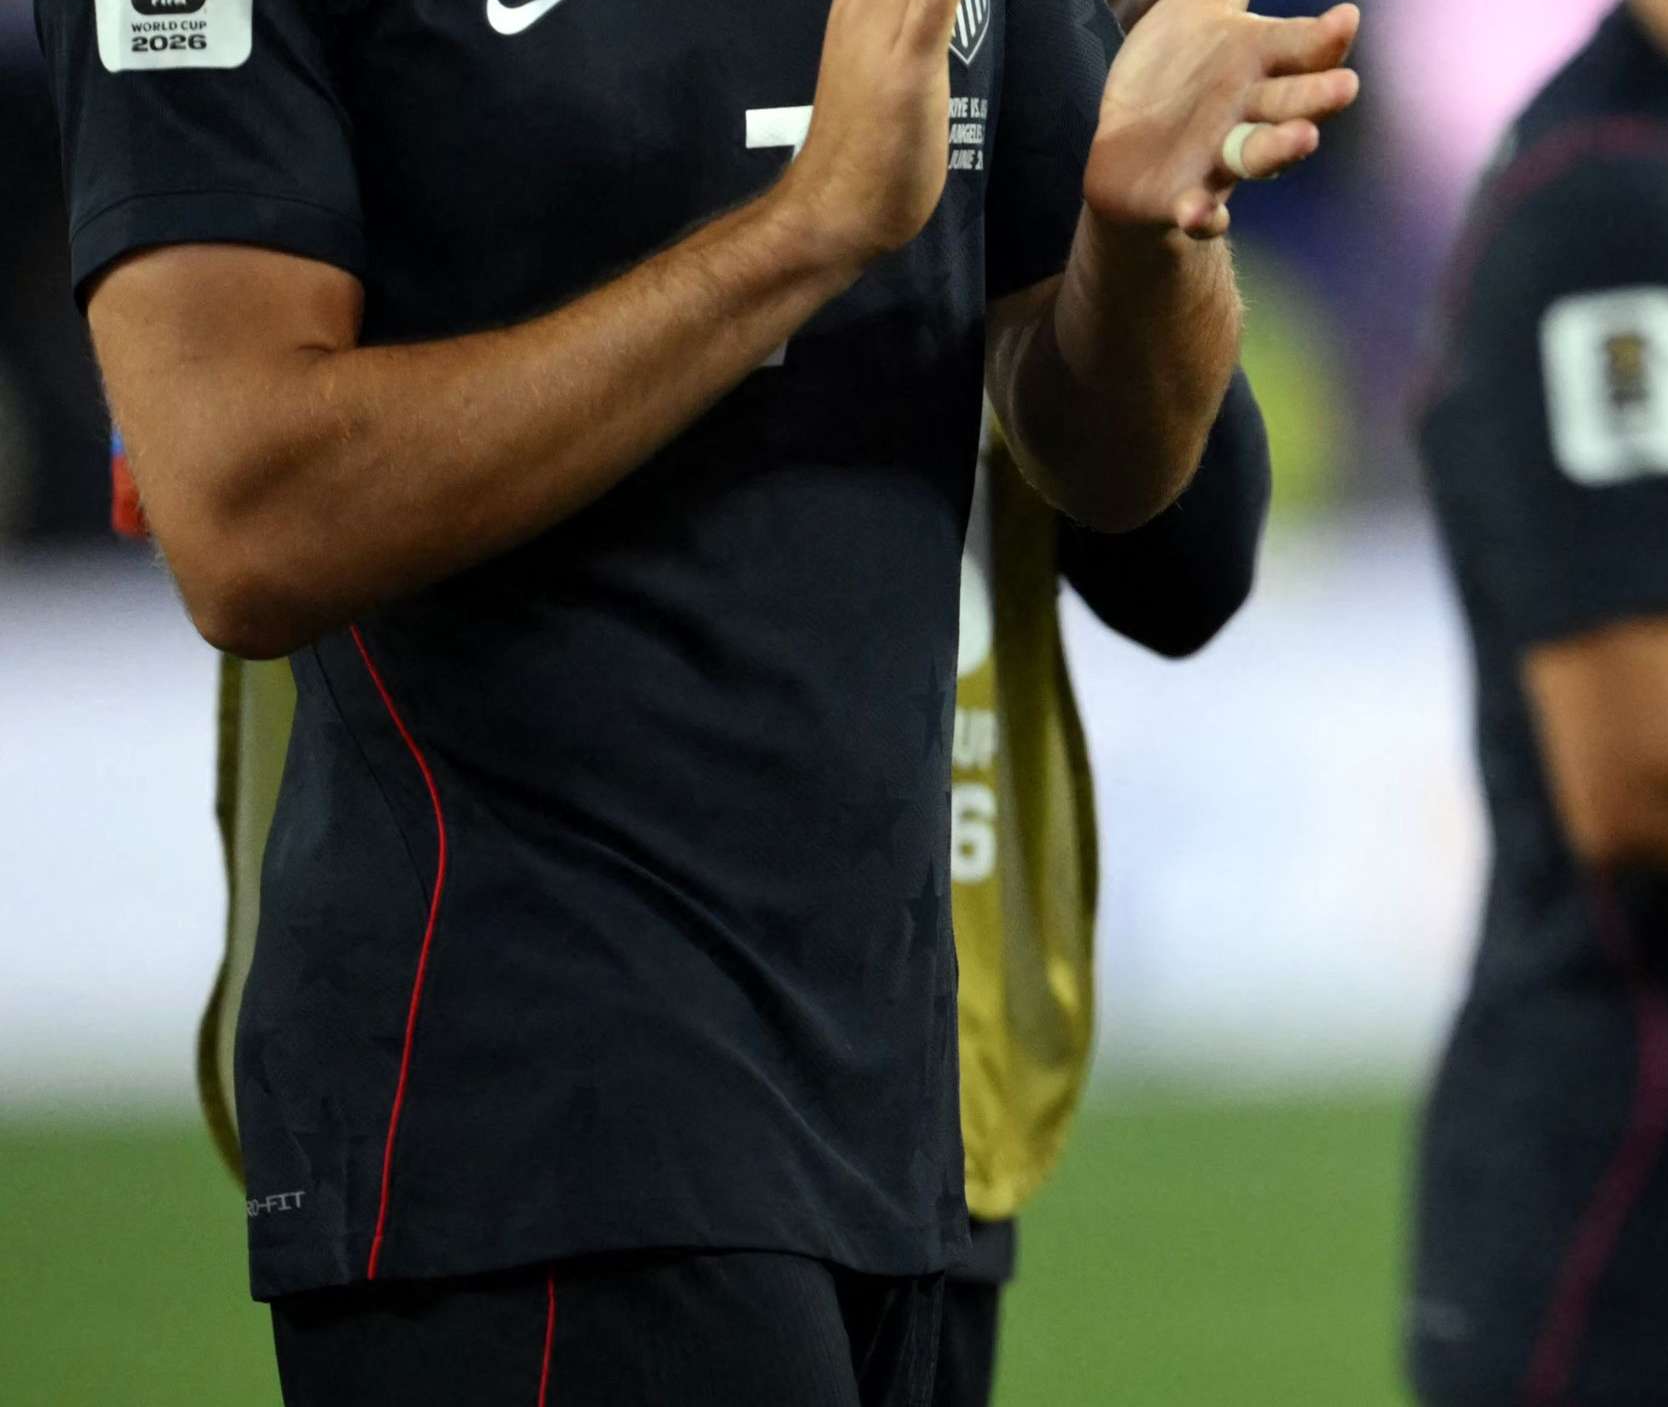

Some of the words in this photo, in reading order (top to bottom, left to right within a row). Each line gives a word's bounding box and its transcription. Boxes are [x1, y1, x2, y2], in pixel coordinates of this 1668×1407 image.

[131, 21, 178, 33] WORLD
[180, 20, 207, 31] CUP
[131, 34, 207, 53] 2026
